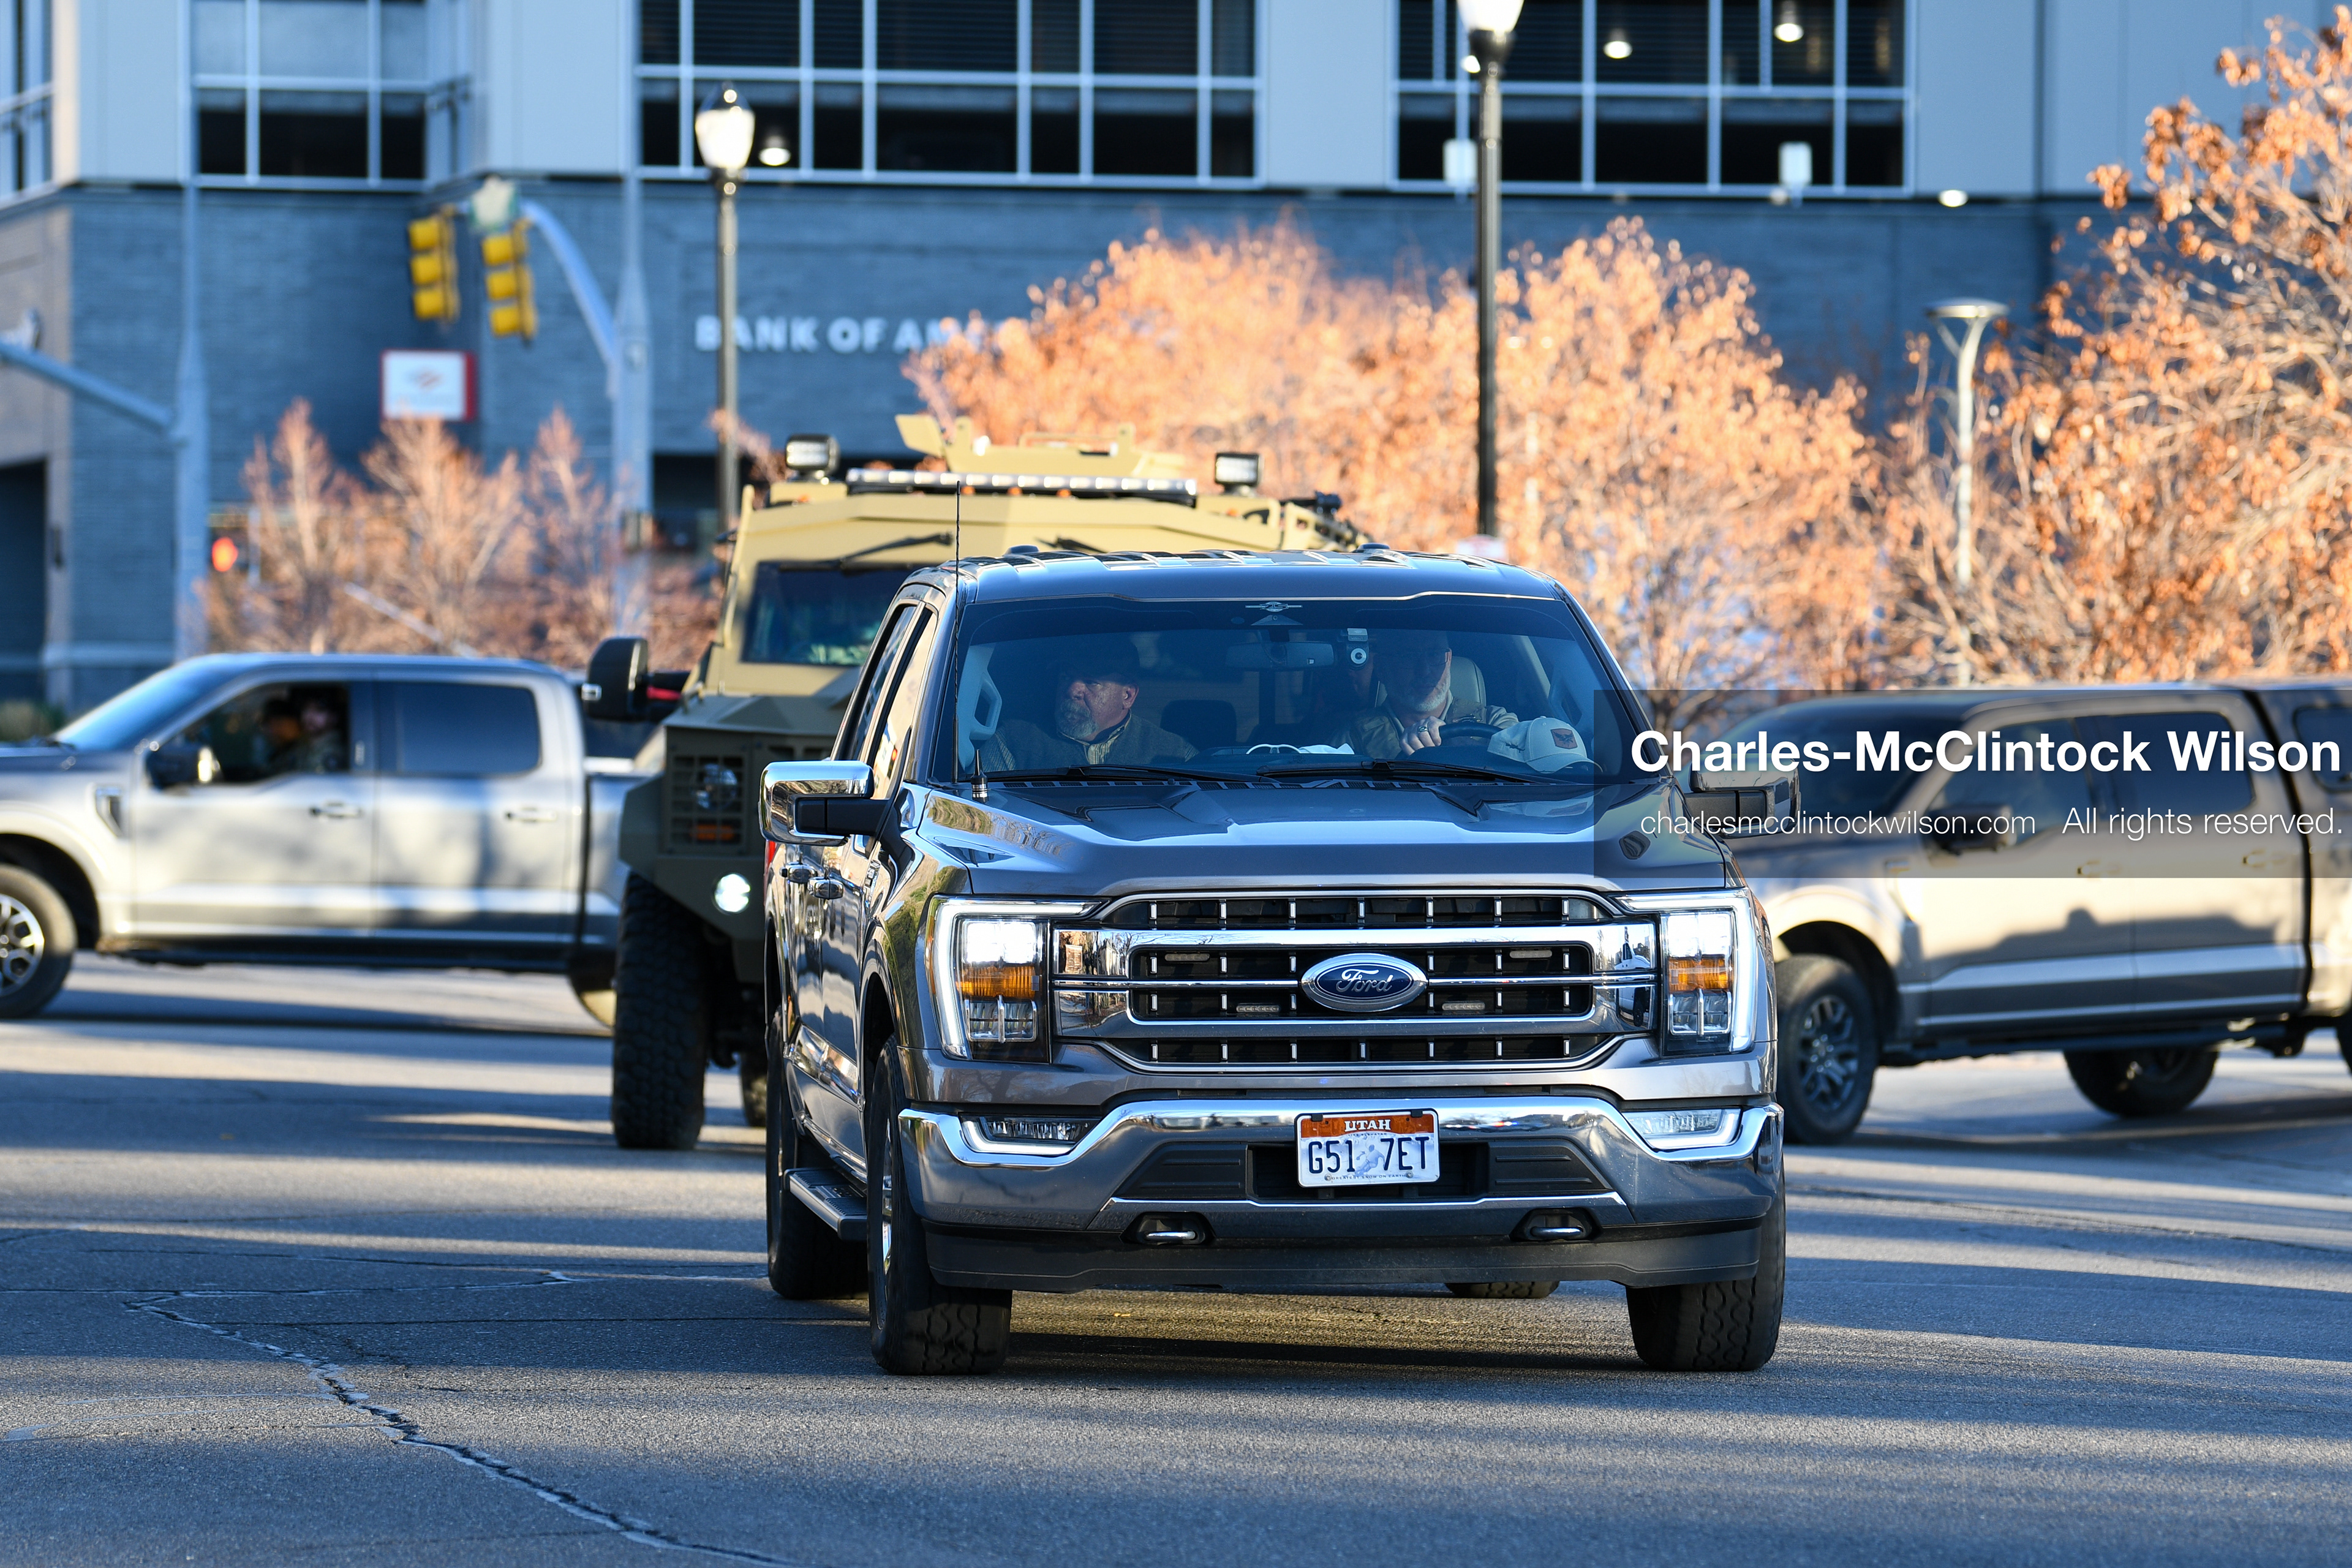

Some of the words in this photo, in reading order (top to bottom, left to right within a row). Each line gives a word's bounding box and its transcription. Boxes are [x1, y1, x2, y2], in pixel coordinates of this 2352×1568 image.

[695, 315, 818, 352] BANK
[827, 317, 889, 353] OF
[1336, 968, 1393, 993] Ford
[1344, 1119, 1391, 1132] UTAH
[1308, 1140, 1355, 1174] G51
[1381, 1137, 1430, 1170] 7ET
